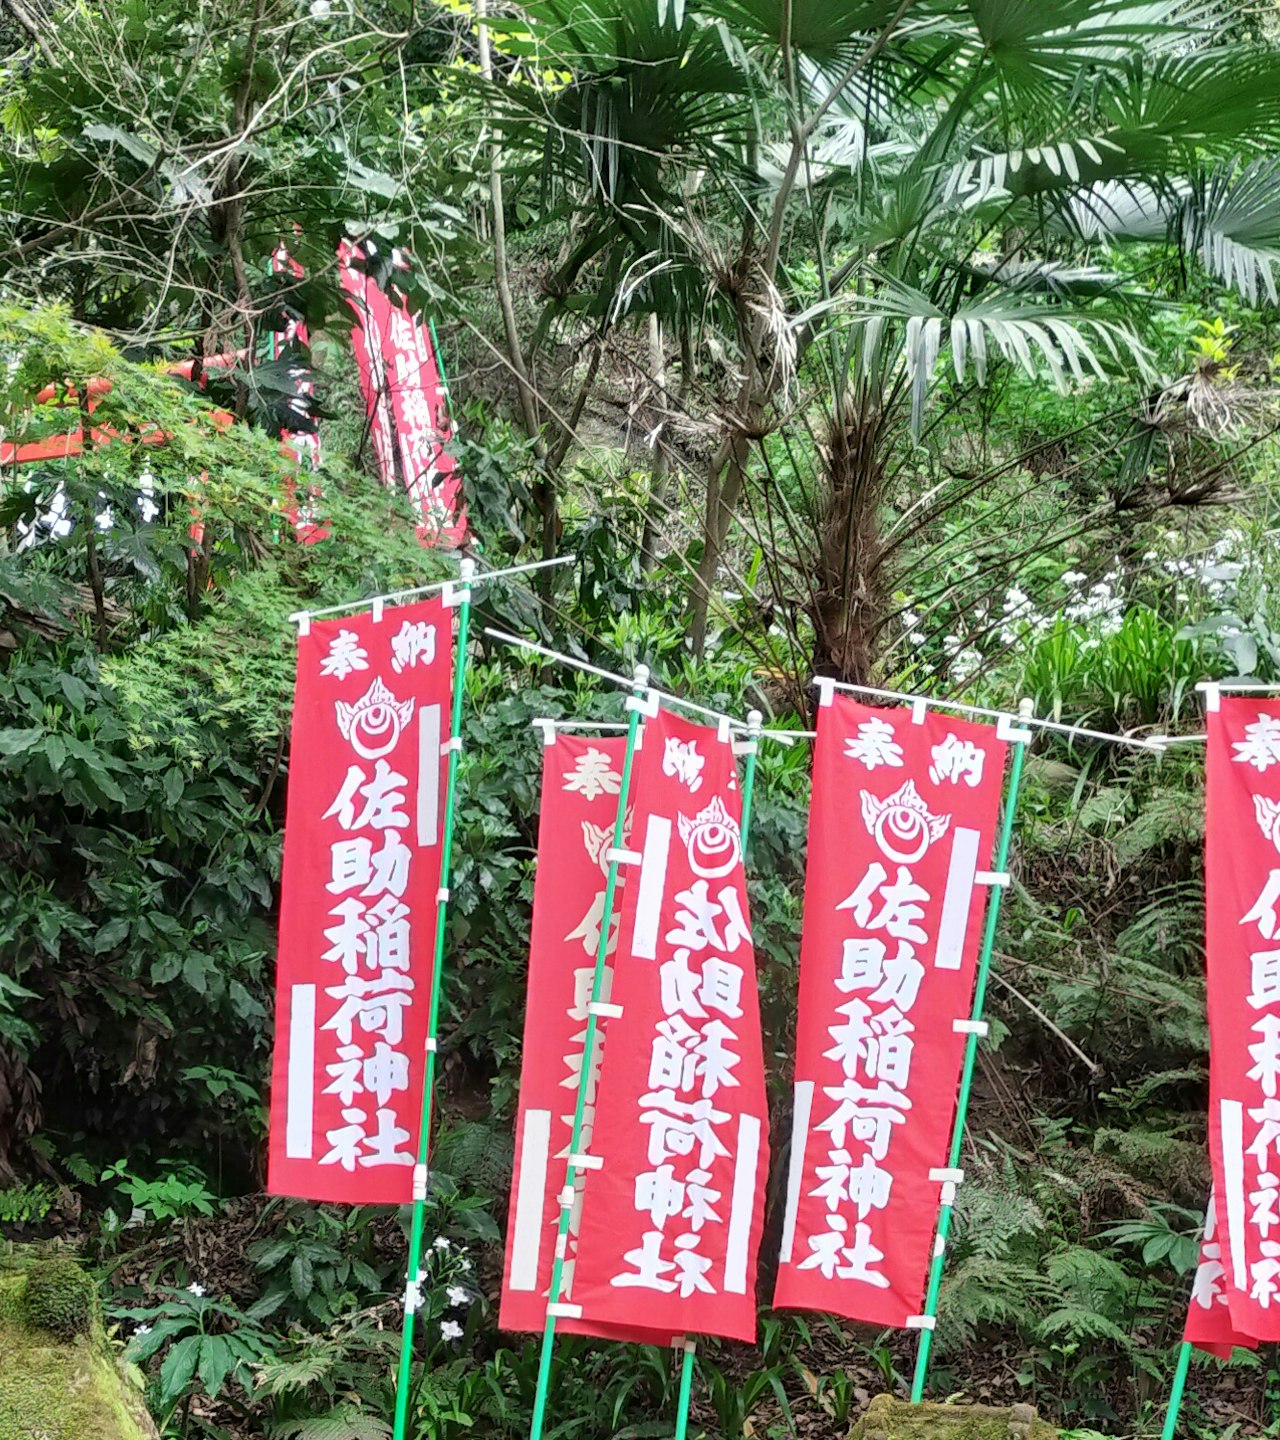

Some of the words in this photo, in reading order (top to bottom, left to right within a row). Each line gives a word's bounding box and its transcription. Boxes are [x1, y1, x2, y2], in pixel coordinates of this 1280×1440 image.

[320, 620, 435, 680] 奉納
[843, 717, 985, 788] 奉納
[320, 760, 416, 1172] 佐助稲荷神社
[797, 862, 929, 1288] 佐助稲荷神社
